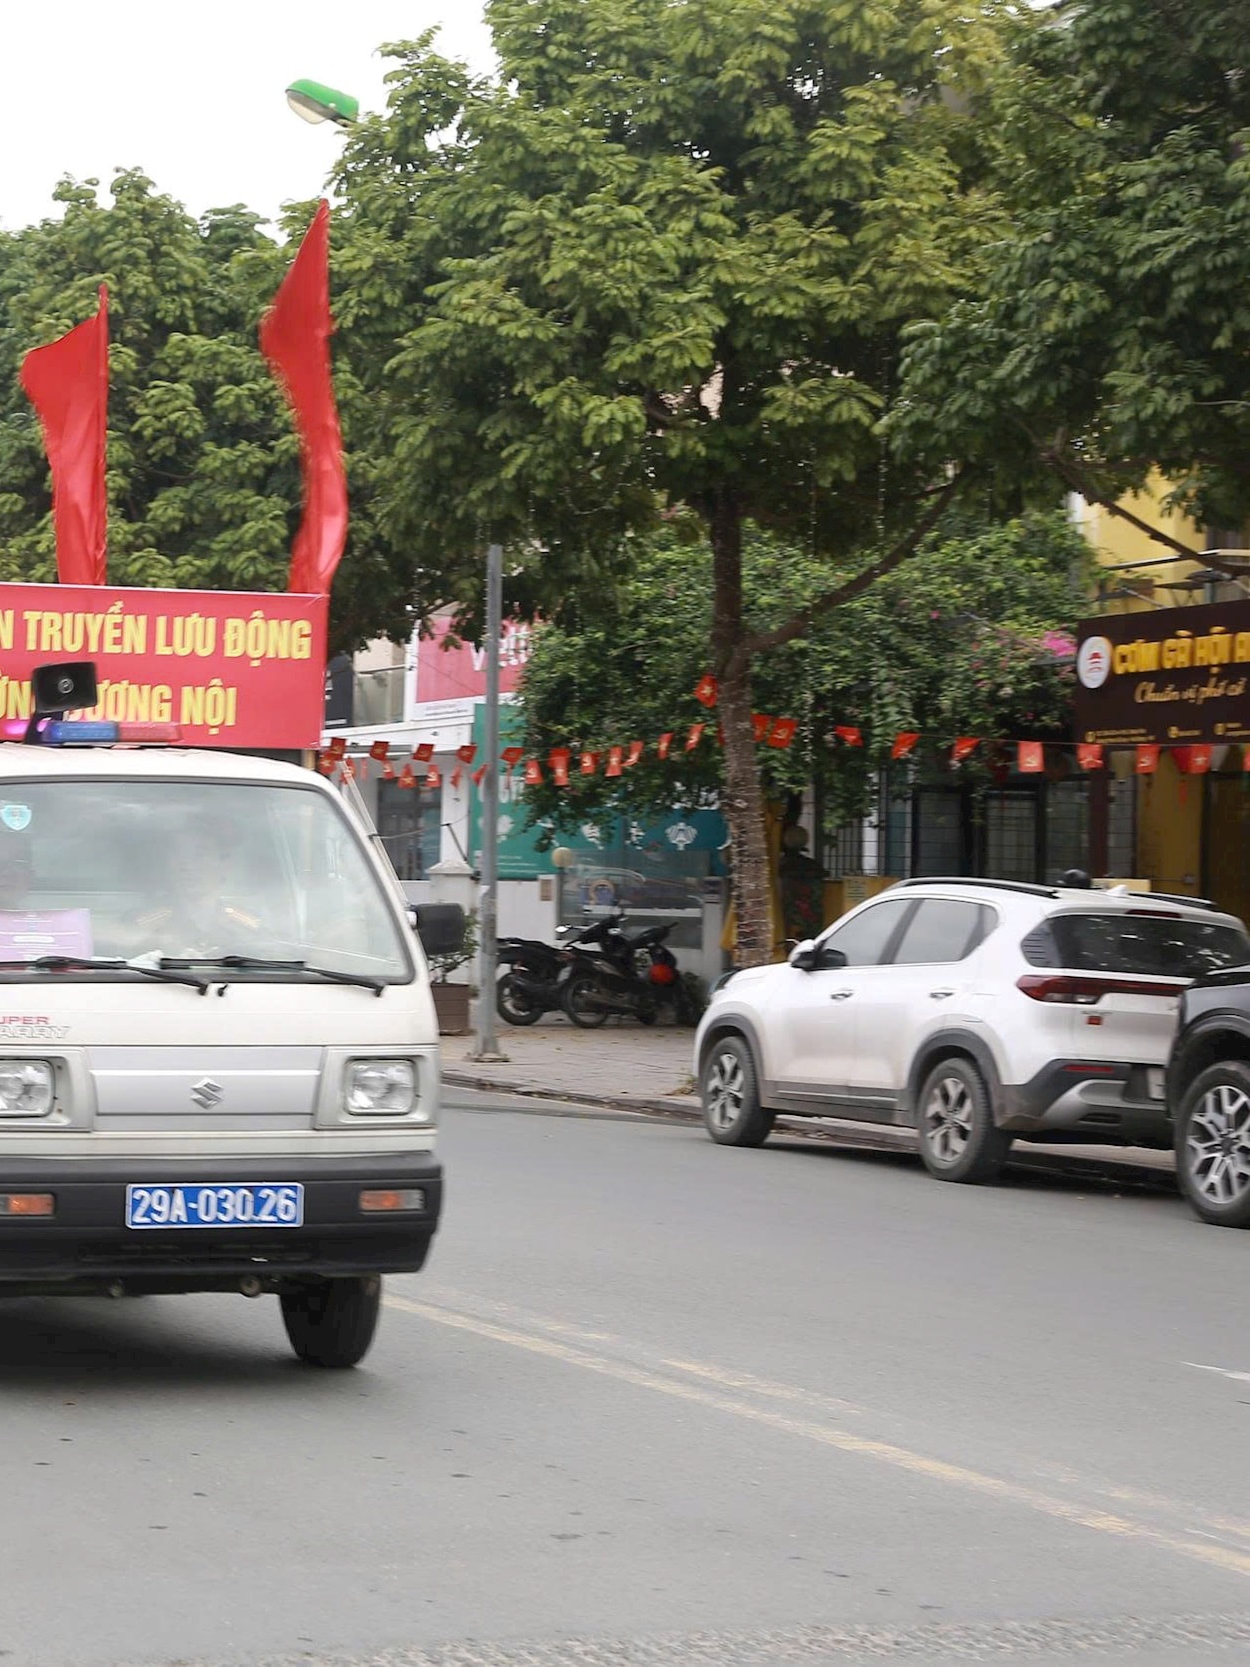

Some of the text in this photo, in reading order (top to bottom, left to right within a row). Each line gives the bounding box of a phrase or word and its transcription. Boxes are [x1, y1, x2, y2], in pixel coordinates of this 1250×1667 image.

[155, 612, 217, 657] LƯU
[223, 610, 312, 667] ĐỘNG
[63, 679, 172, 722] ƯƠNG
[181, 678, 237, 735] NỘI
[131, 1187, 298, 1223] 29A-030.26
